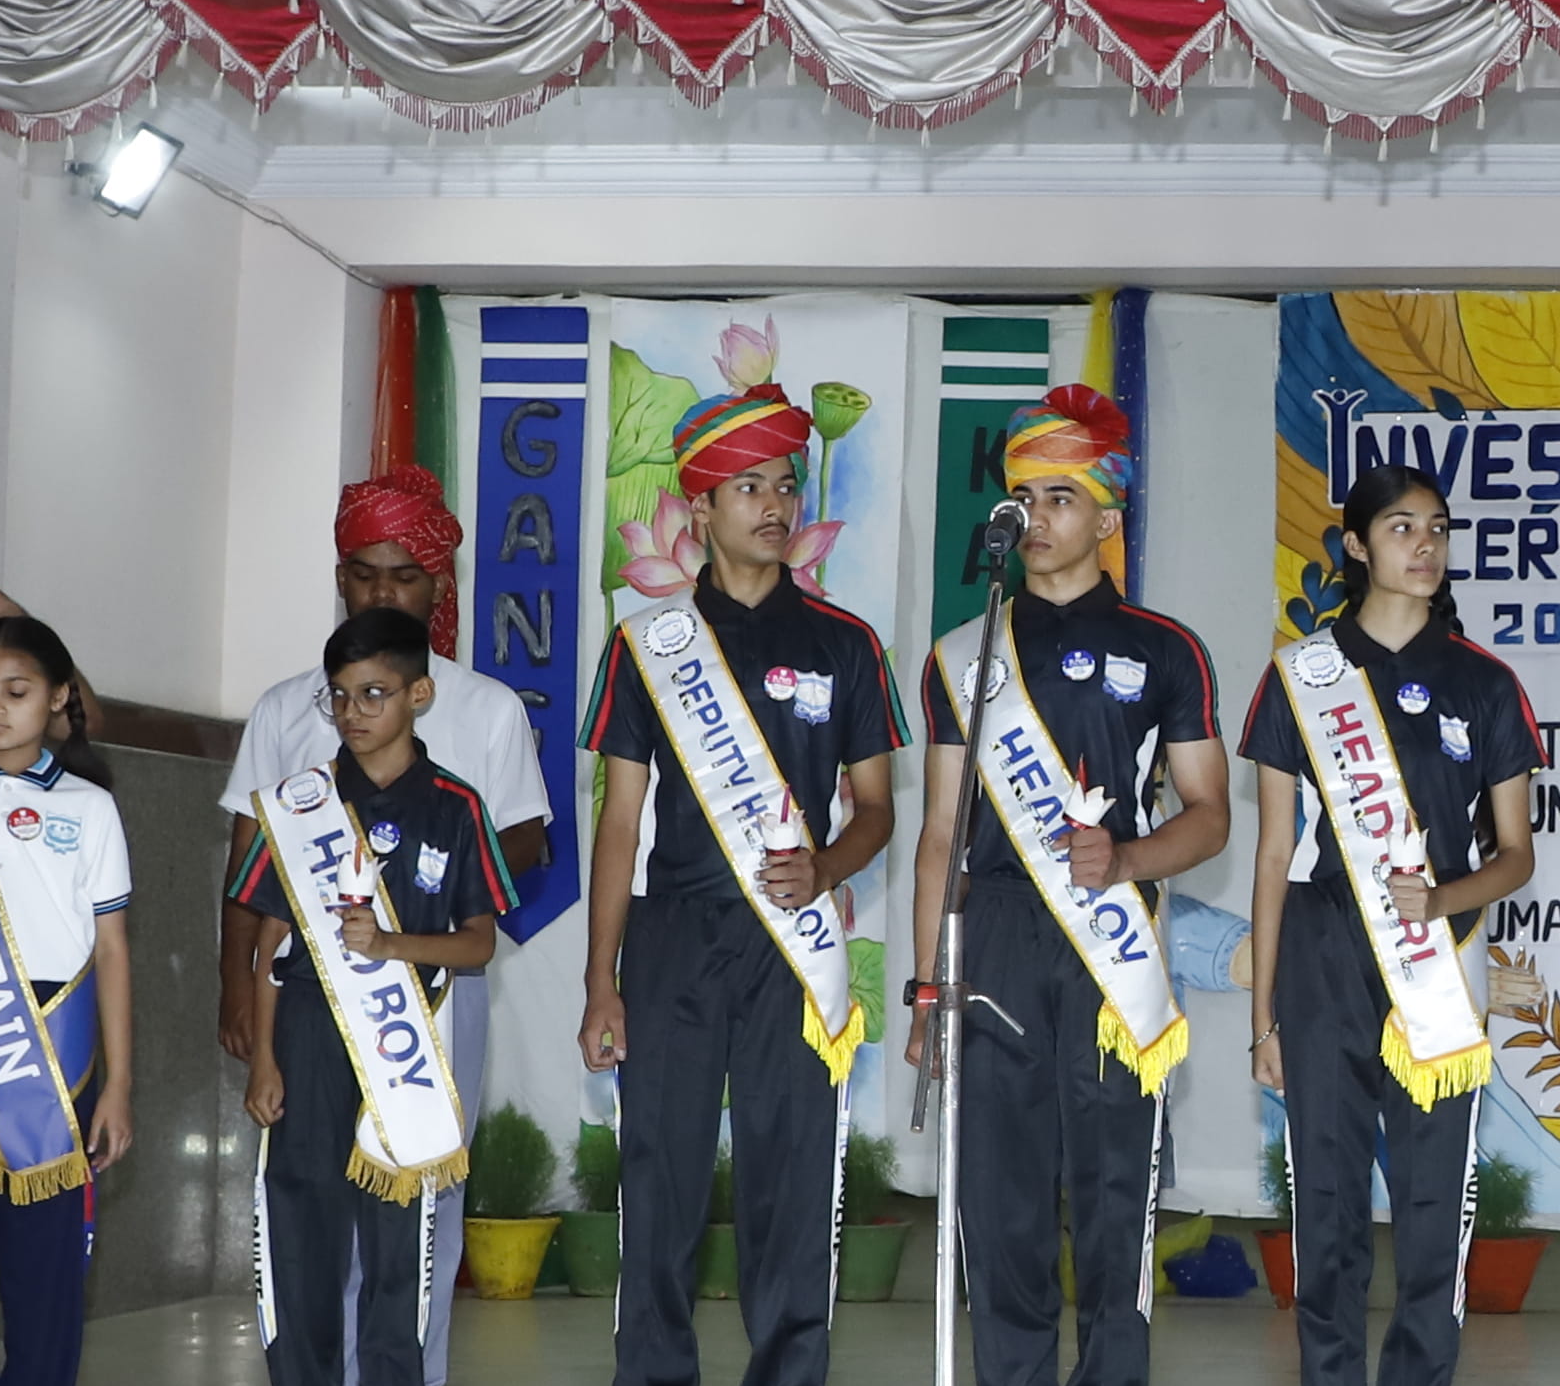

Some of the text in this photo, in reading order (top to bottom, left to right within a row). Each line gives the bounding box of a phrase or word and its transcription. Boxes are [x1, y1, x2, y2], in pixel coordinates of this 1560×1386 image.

[671, 659, 756, 789] DEPUTY
[1320, 702, 1395, 840] HEAD
[360, 982, 435, 1089] BOY
